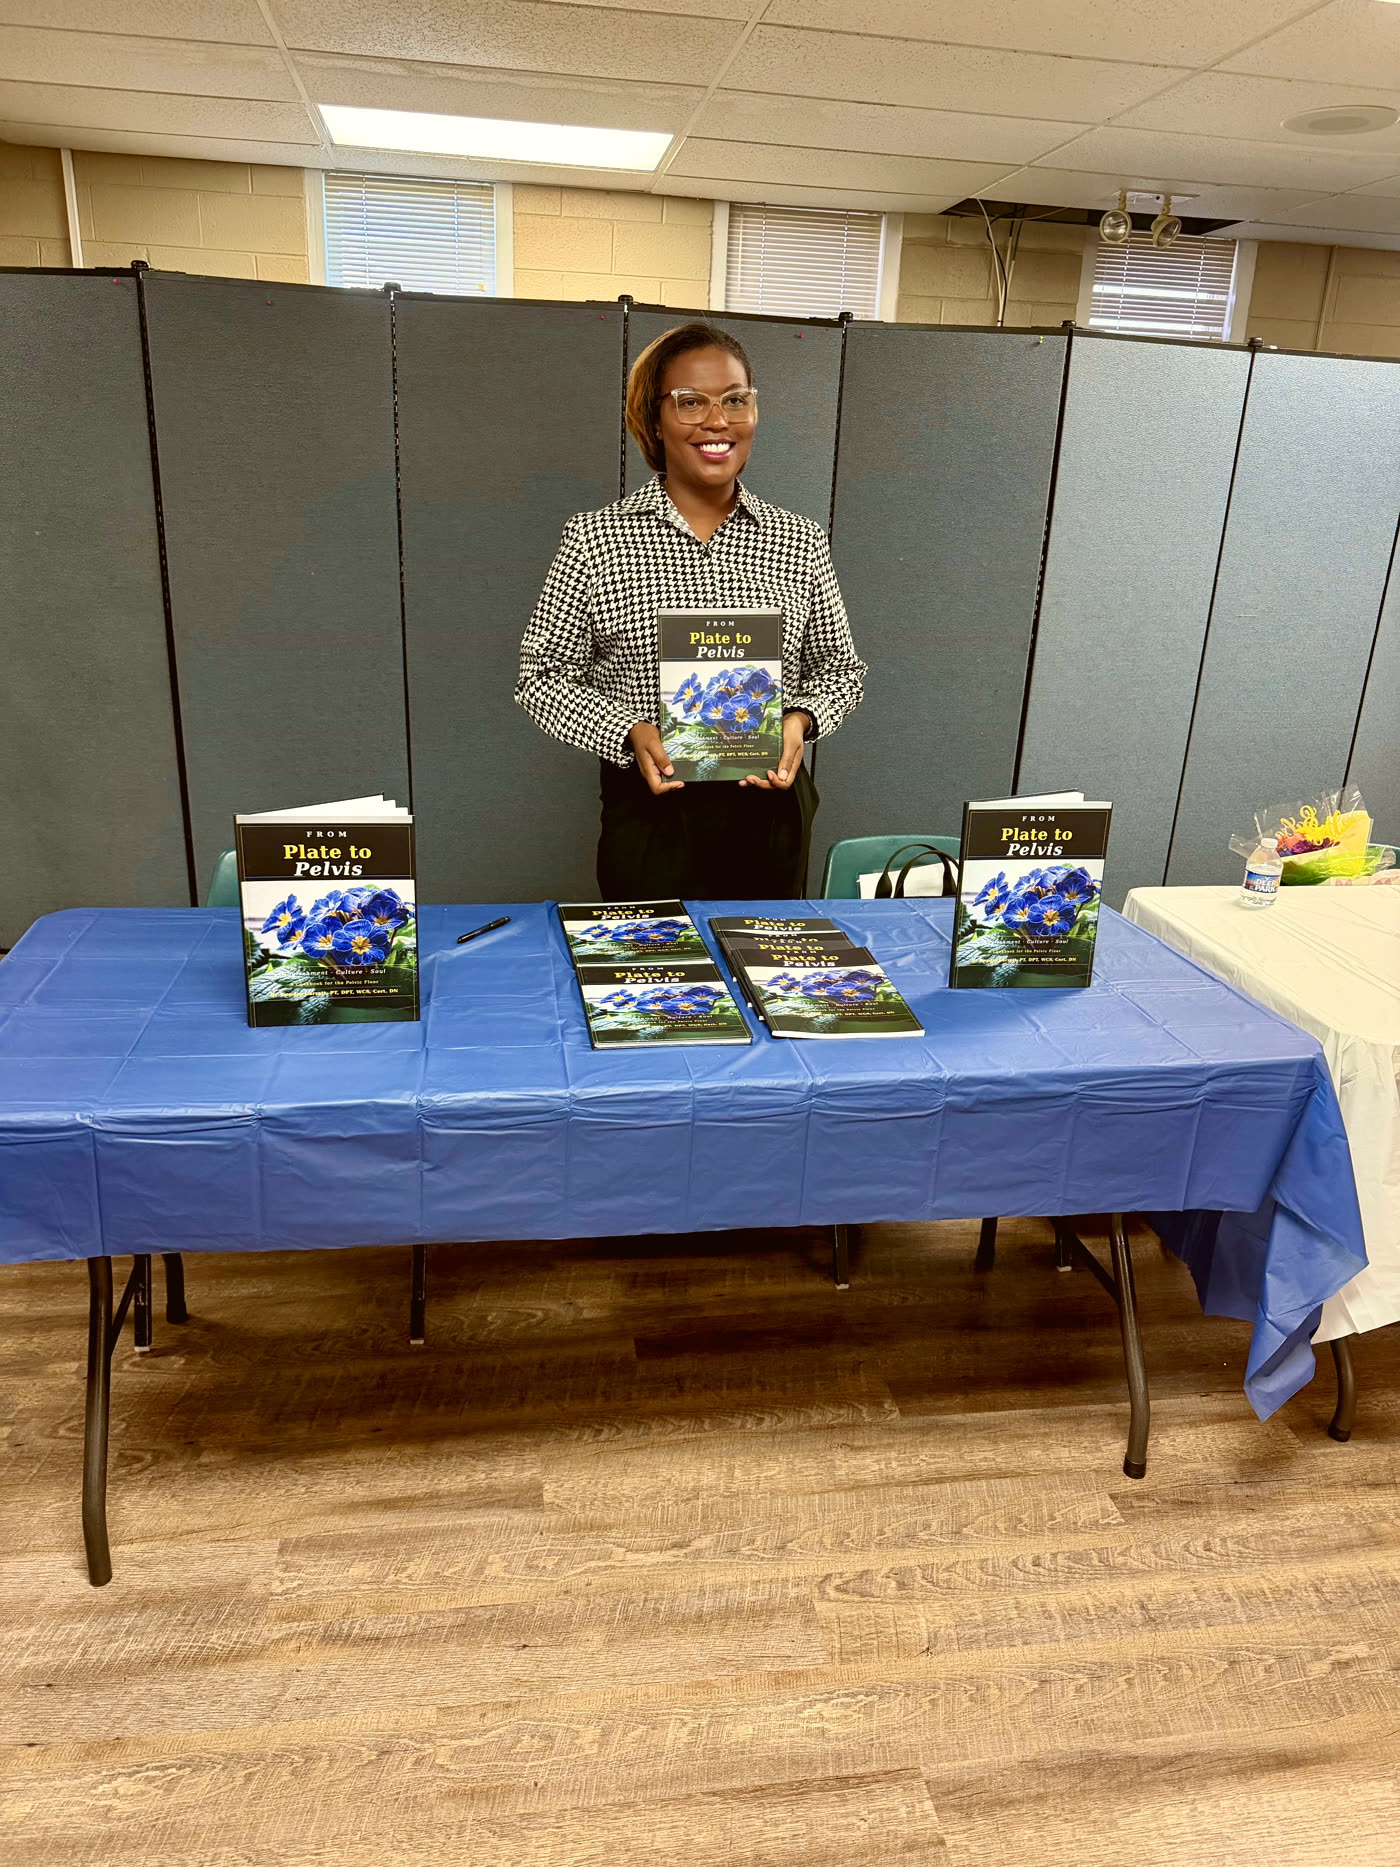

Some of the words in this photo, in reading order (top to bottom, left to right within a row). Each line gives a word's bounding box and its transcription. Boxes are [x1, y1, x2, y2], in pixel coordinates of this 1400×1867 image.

[689, 632, 730, 644] Plate
[736, 633, 751, 644] to
[696, 646, 745, 658] Pelvis
[1000, 827, 1048, 841] Plate
[1054, 828, 1073, 841] to
[283, 845, 342, 860] Plate
[349, 845, 372, 859] to
[1006, 843, 1063, 856] Pelvis
[294, 861, 363, 877] Pelvis
